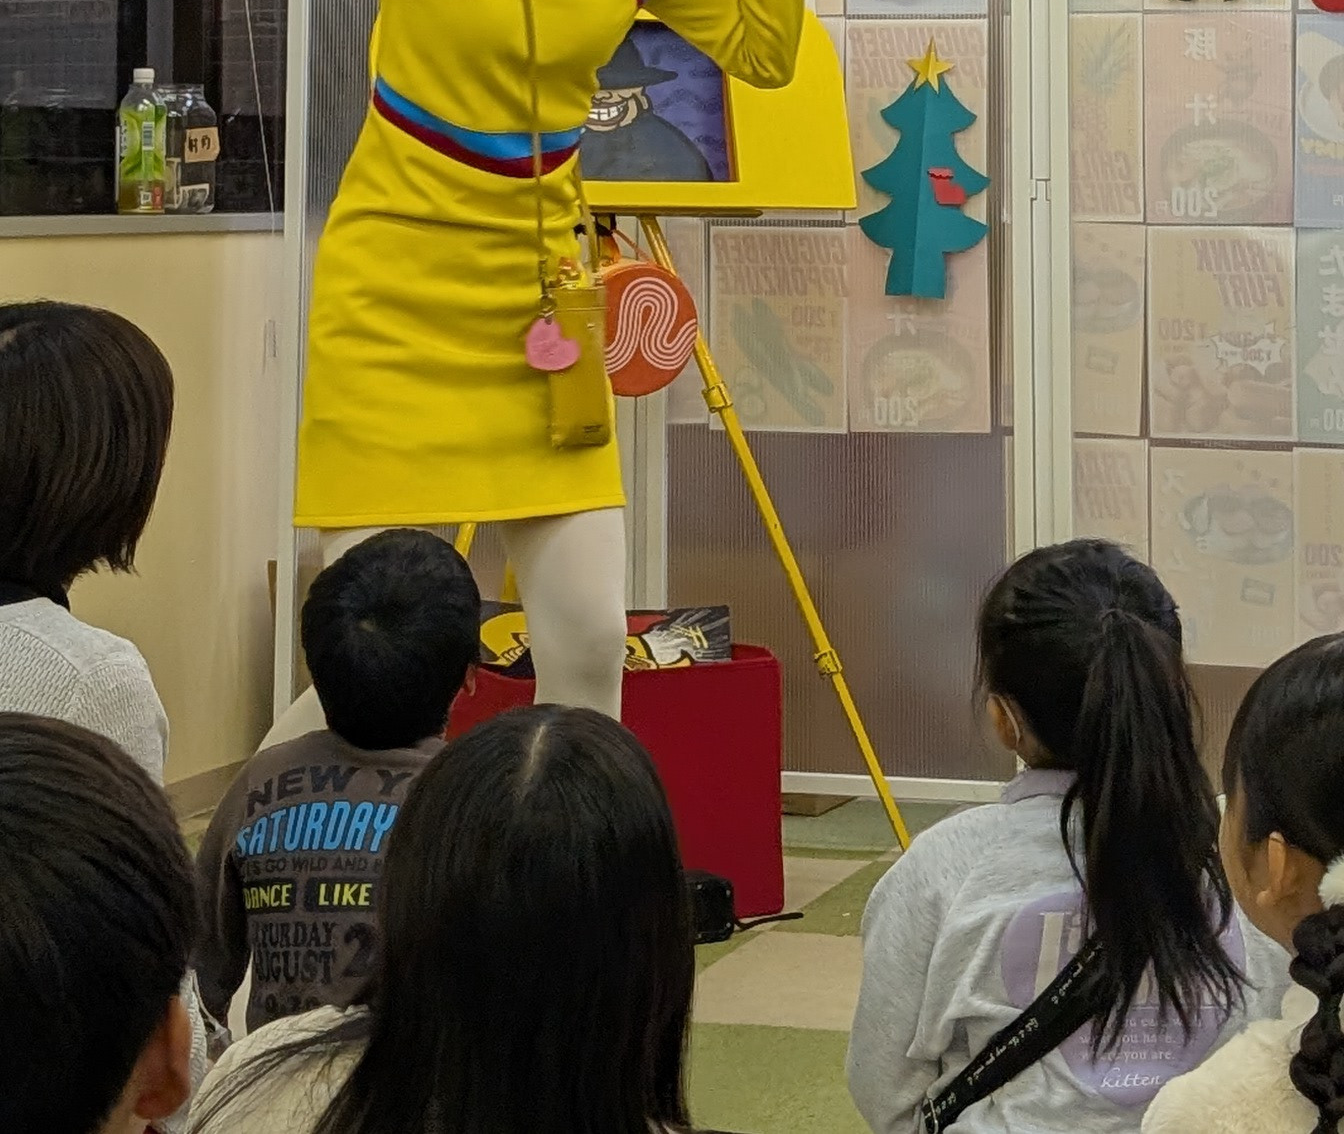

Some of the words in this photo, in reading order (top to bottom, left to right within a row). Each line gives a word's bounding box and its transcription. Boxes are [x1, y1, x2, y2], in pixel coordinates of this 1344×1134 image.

[246, 766, 359, 816] NEW
[376, 769, 413, 797] Y
[235, 800, 400, 858] SATURDAY
[243, 883, 293, 910] DANCE
[318, 882, 373, 907] LIKE
[1100, 1067, 1161, 1089] kitten
